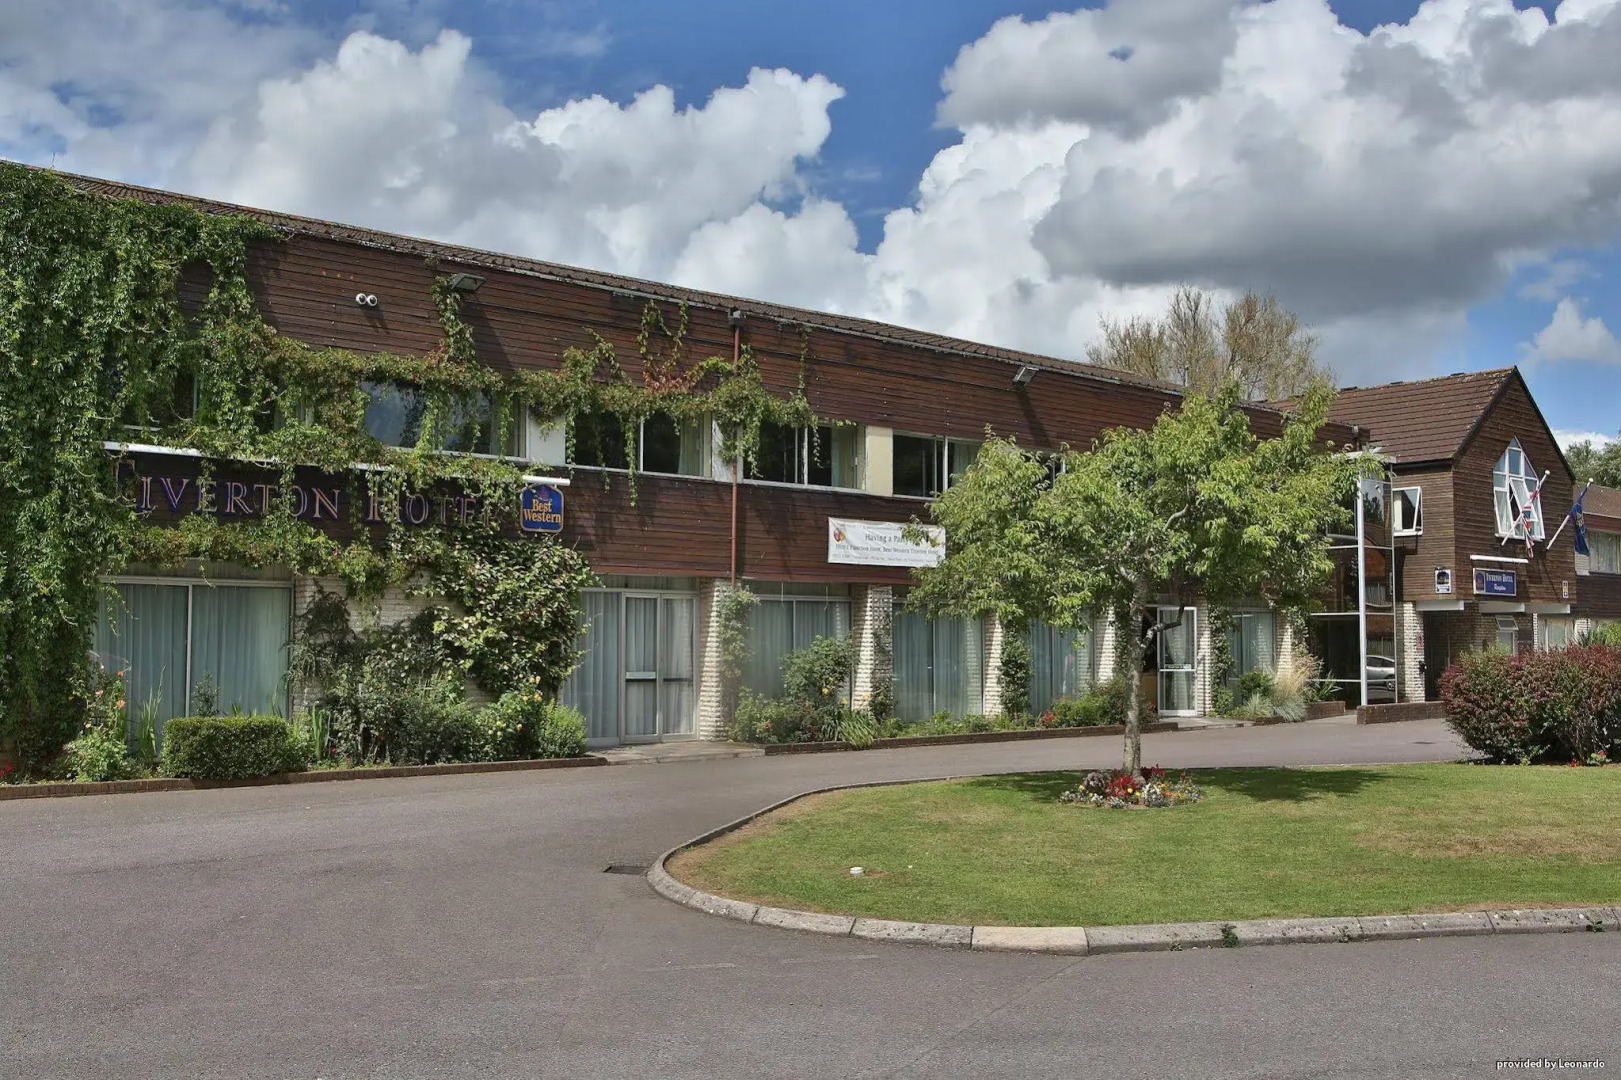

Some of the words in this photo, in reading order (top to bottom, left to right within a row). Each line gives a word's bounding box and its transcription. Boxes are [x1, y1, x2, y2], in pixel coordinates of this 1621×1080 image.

[532, 498, 552, 512] Best
[523, 508, 561, 523] Western
[865, 533, 887, 543] Having
